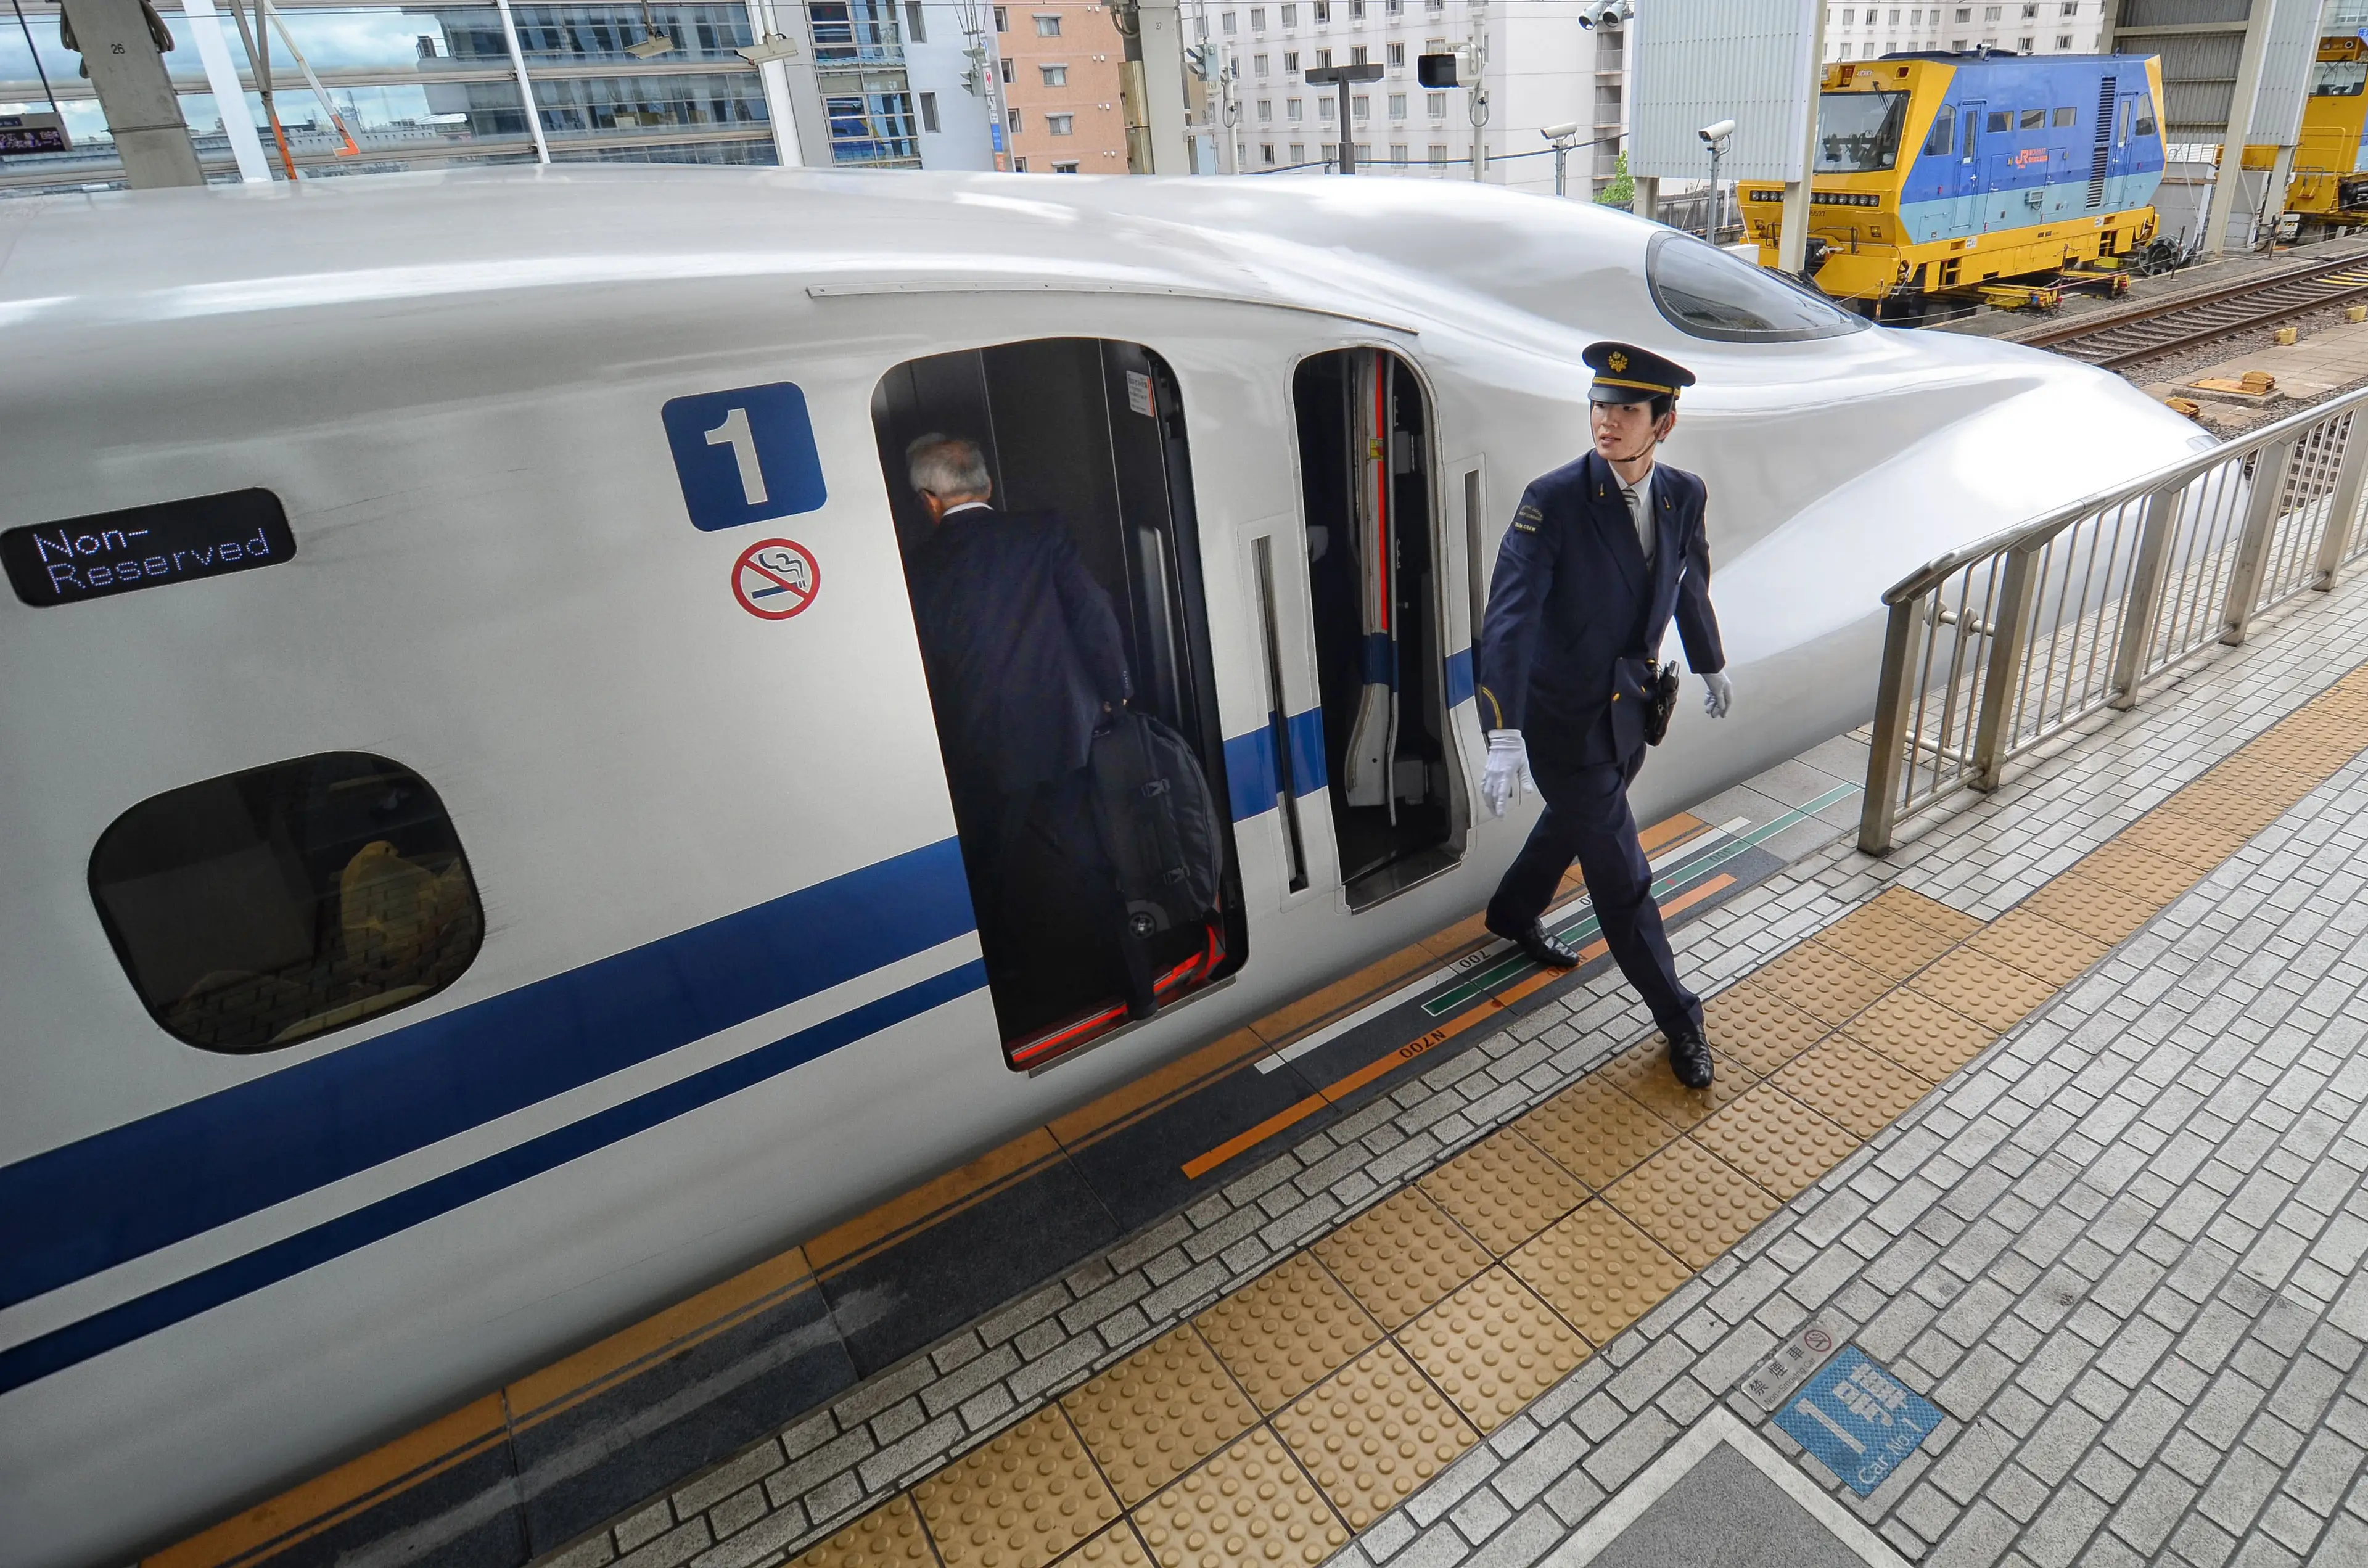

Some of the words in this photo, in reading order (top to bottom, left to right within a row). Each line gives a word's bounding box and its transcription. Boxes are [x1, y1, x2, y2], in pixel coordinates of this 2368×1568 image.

[1155, 22, 1162, 30] 27
[111, 44, 126, 55] 26
[2015, 150, 2028, 164] JR
[704, 407, 768, 506] 1
[33, 528, 149, 563] Non-
[46, 528, 270, 594] Reserved
[1459, 950, 1491, 968] 700
[1399, 1030, 1447, 1059] N700
[1749, 1344, 1805, 1397] 禁煙車
[1803, 1357, 1816, 1369] Car
[1858, 1455, 1889, 1485] Car
